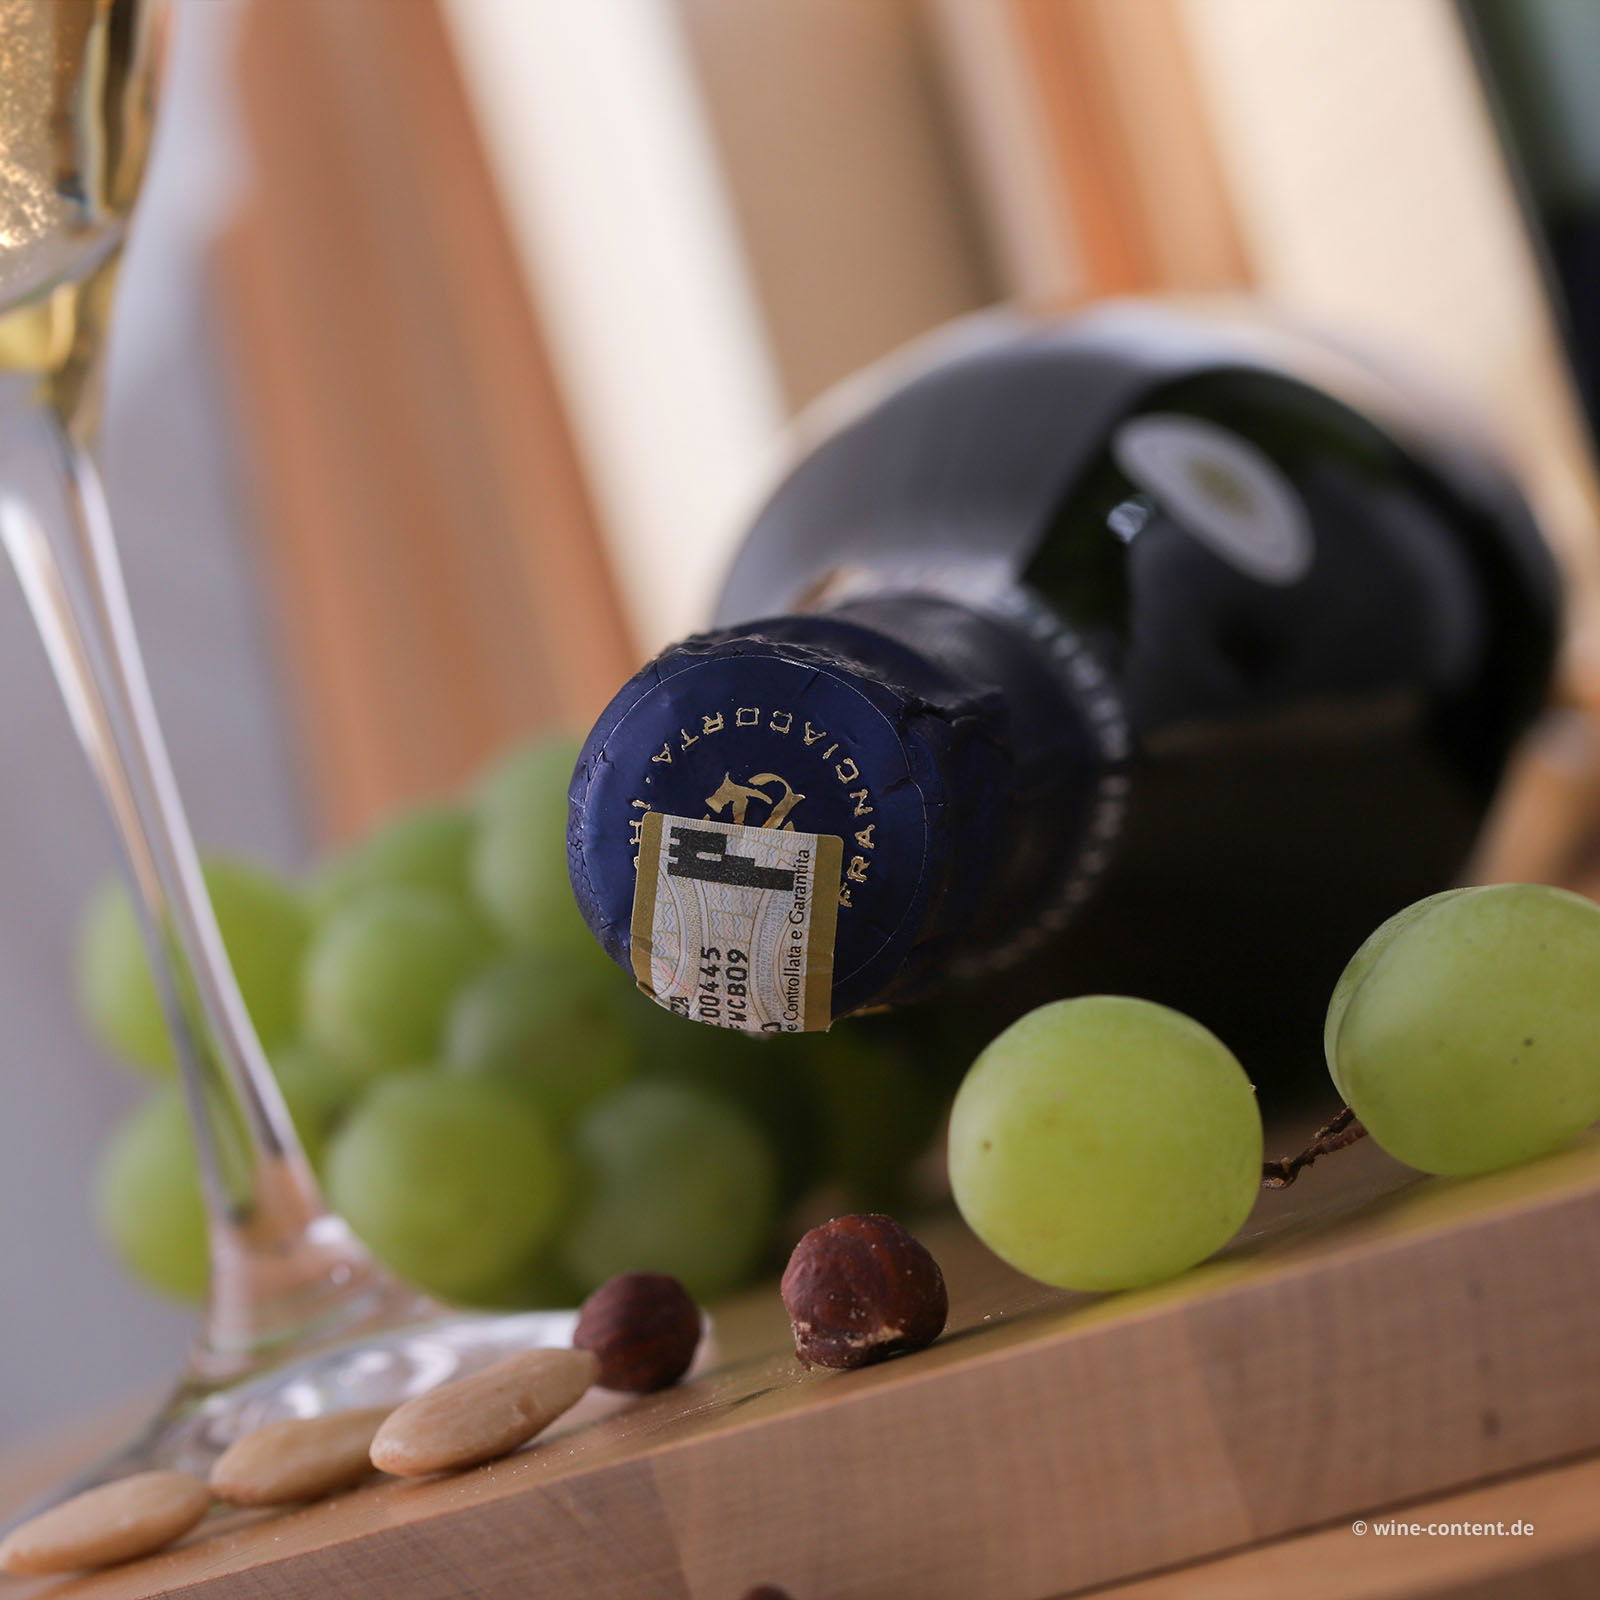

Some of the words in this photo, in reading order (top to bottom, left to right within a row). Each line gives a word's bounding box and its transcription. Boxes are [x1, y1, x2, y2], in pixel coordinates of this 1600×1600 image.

[651, 706, 877, 908] FRANCIACORTA
[788, 849, 810, 925] Garantita
[791, 929, 803, 941] e
[699, 946, 722, 1027] 00445
[783, 945, 802, 1022] Controllata
